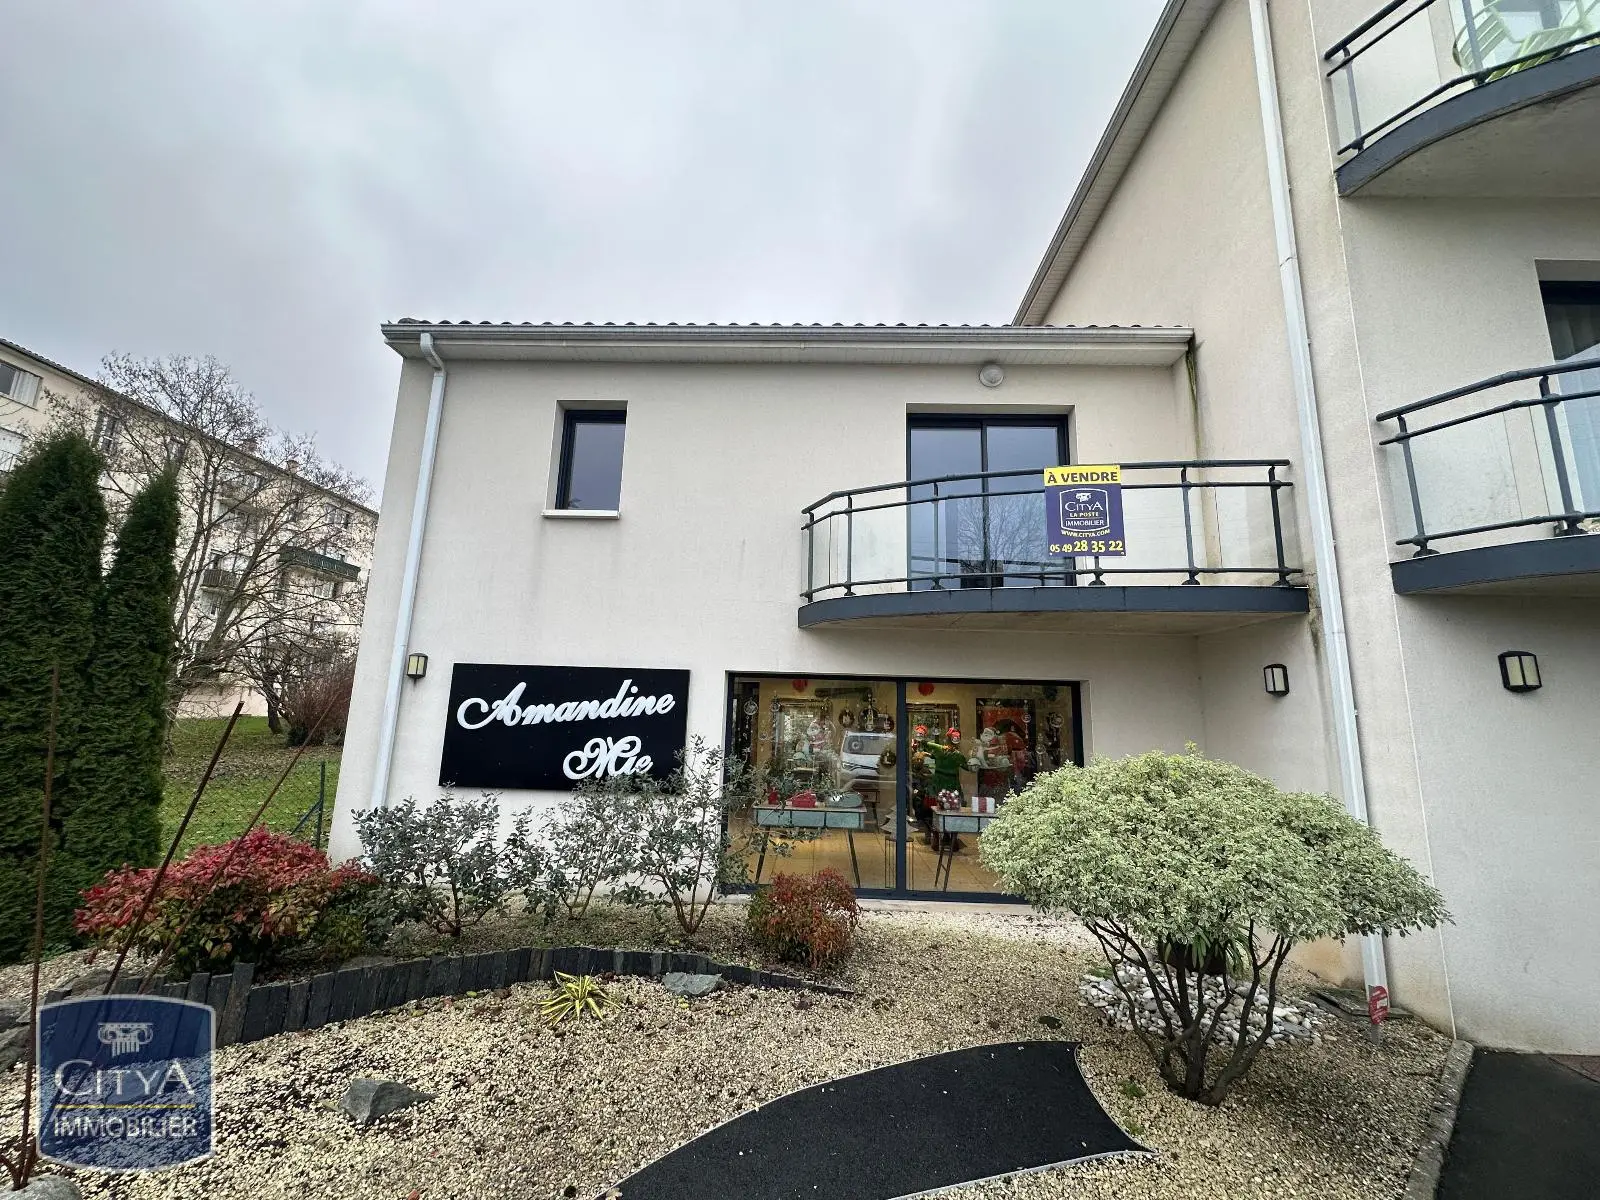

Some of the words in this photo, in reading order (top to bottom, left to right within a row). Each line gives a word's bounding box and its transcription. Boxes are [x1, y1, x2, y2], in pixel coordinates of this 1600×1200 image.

[1047, 472, 1057, 483] À
[1061, 472, 1118, 482] VENDRE
[1065, 519, 1105, 527] IMMOBILIER
[1061, 528, 1110, 537] WWW.CITYA.COM
[1049, 544, 1060, 553] 05
[1061, 543, 1073, 553] 49
[1073, 540, 1089, 552] 28
[1091, 540, 1106, 553] 35
[1108, 540, 1124, 551] 22
[456, 679, 676, 730] Amandine
